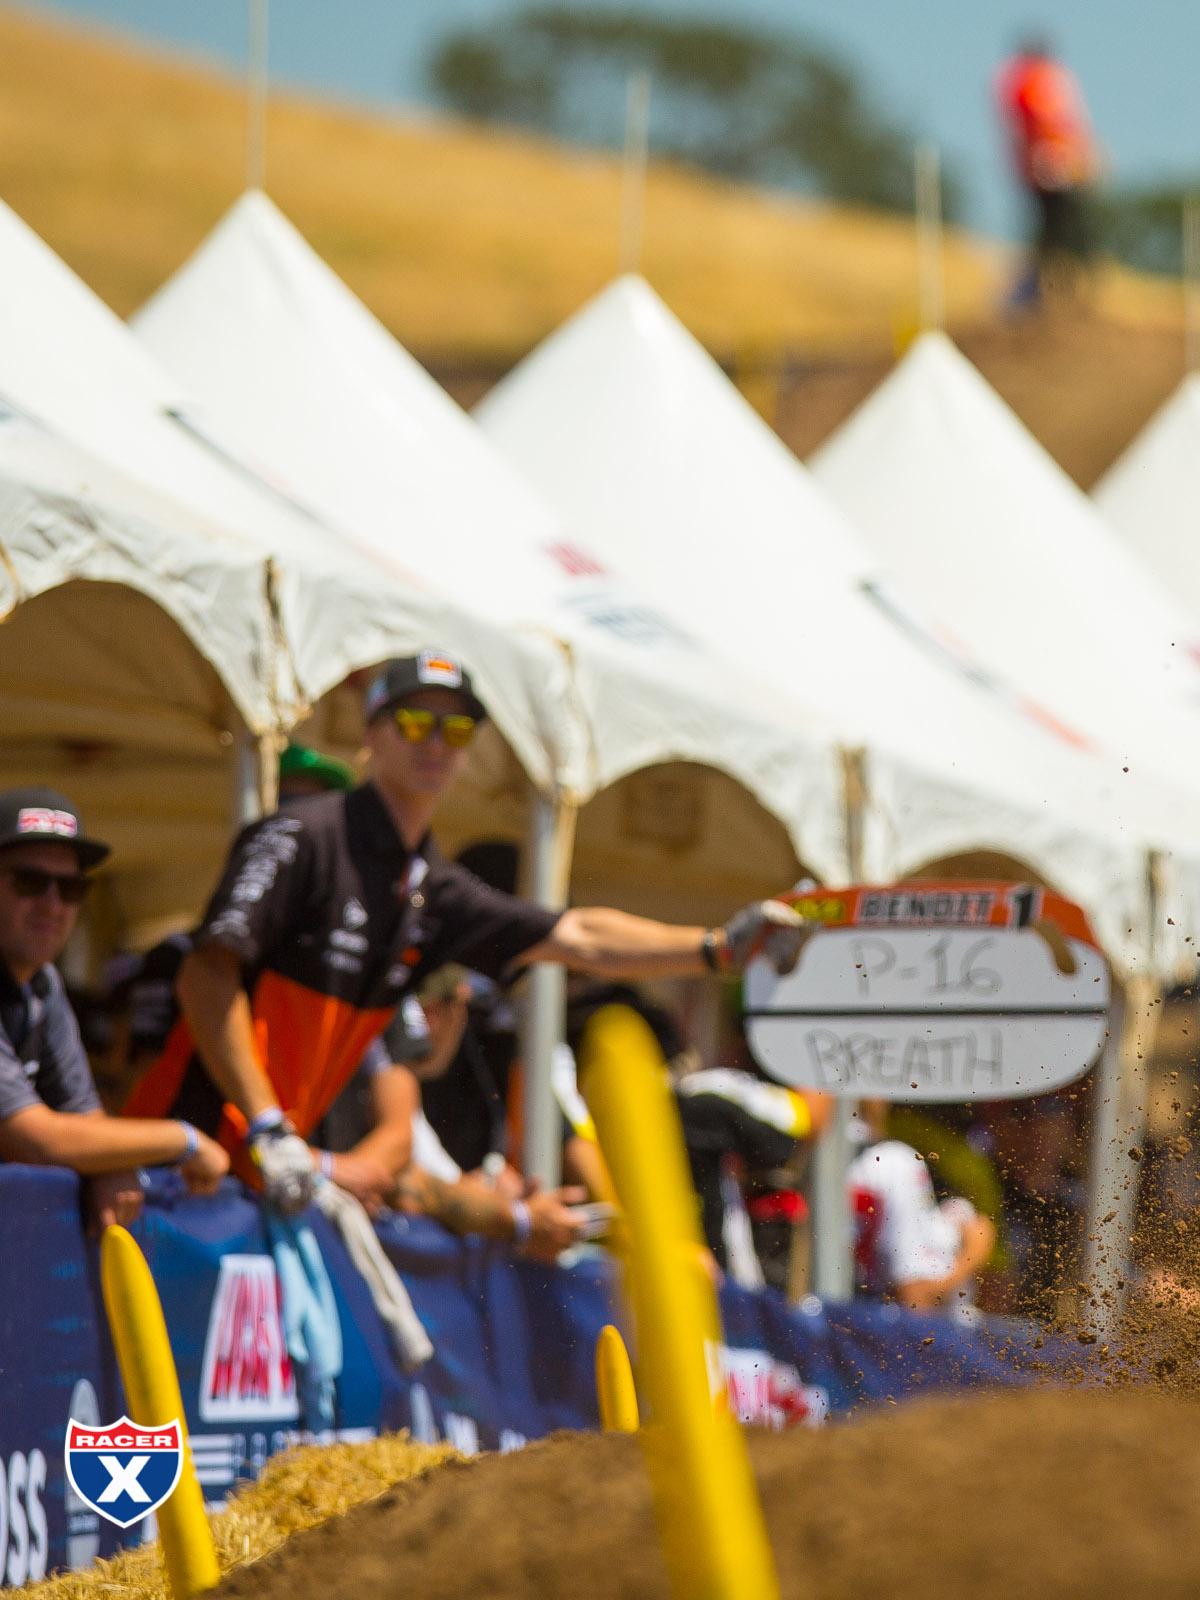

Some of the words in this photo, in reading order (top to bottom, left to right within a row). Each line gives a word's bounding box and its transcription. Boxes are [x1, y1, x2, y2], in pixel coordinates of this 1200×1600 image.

[861, 891, 993, 920] BENOIT
[1009, 888, 1038, 929] 1
[851, 935, 1003, 997] P-16
[805, 1029, 1003, 1089] BREATH
